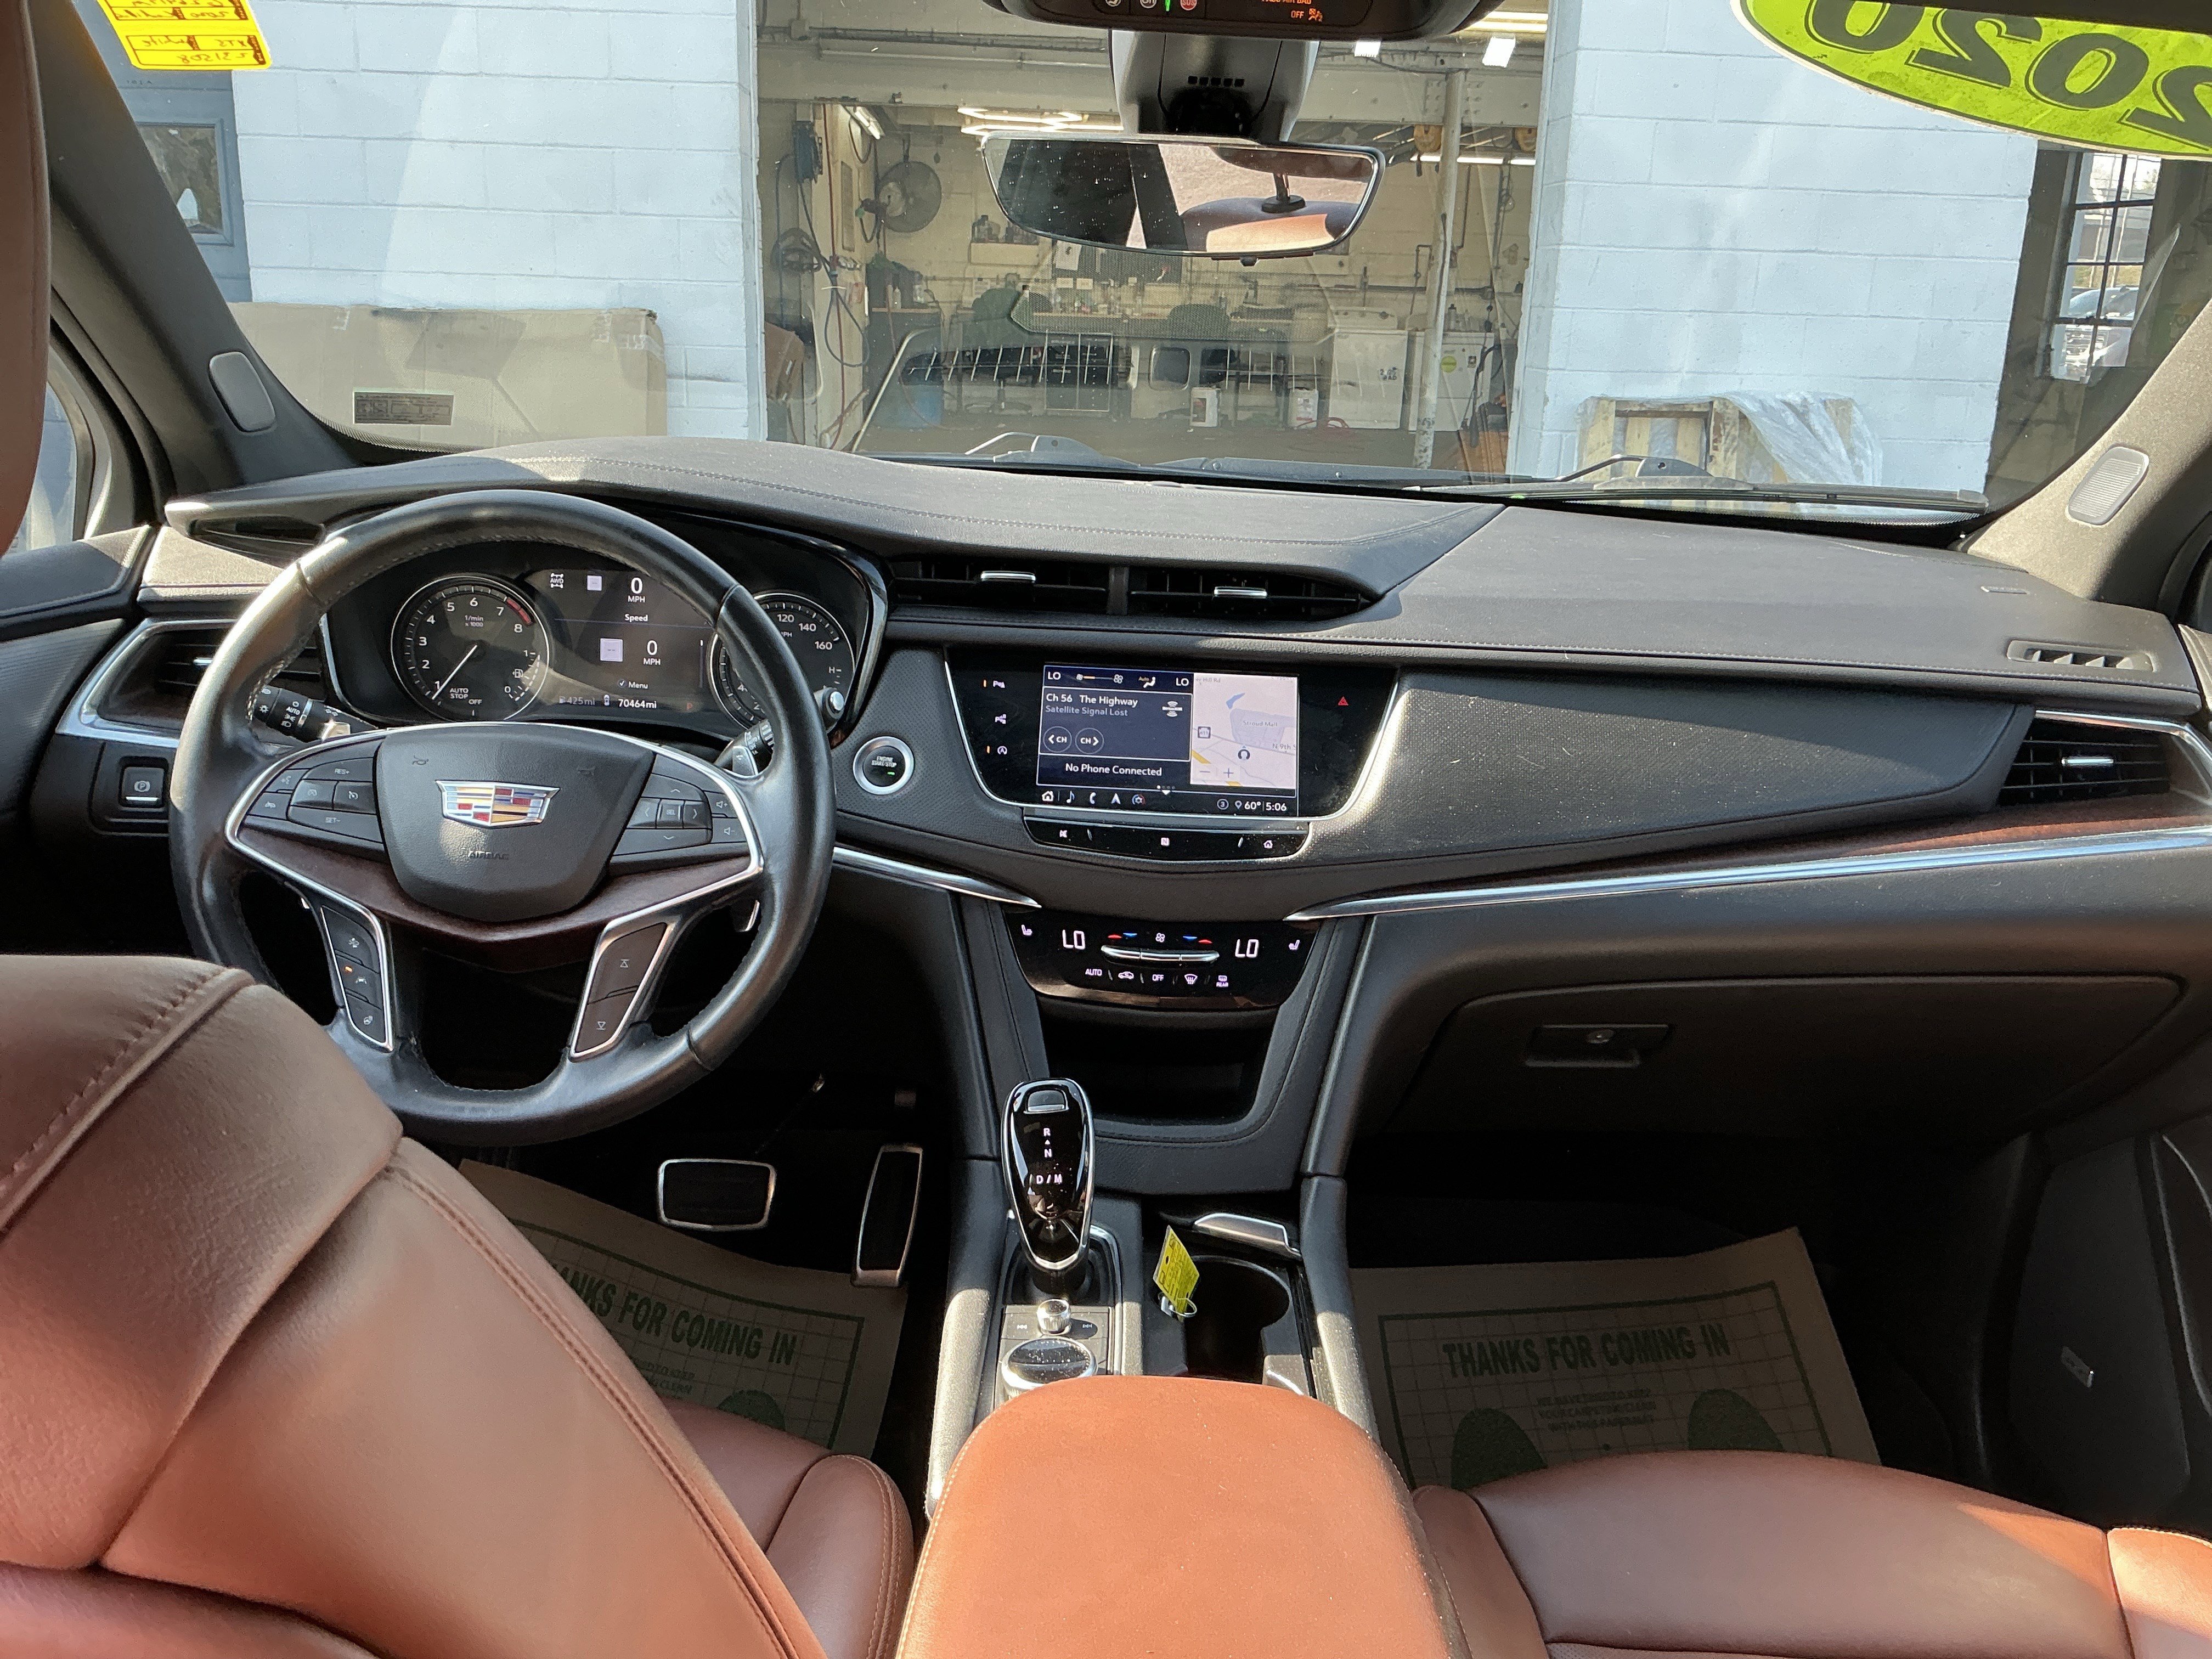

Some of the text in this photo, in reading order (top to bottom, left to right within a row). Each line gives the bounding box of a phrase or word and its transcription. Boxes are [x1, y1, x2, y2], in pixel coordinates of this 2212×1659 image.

[1290, 10, 1305, 19] OFF
[630, 577, 644, 594] 0
[447, 601, 455, 612] 5
[470, 597, 478, 607] 6
[496, 606, 505, 617] 7
[426, 614, 436, 624] 4
[624, 613, 648, 623] Speed
[777, 613, 795, 624] 120
[514, 623, 523, 634] 8
[798, 622, 817, 633] 140
[419, 636, 428, 647] 3
[815, 641, 833, 651] 160
[523, 649, 529, 657] 1
[646, 640, 658, 656] 0
[421, 659, 430, 669] 2
[643, 658, 662, 666] MPH
[828, 666, 836, 674] H
[1047, 671, 1062, 680] LO
[434, 680, 441, 690] 1
[628, 680, 648, 690] Menu
[1175, 677, 1189, 687] LO
[504, 685, 511, 695] 0
[1046, 692, 1138, 708] Ch 56 The Highway
[286, 706, 301, 715] AUTO
[1045, 704, 1128, 718] Satellite Signal Lost
[1080, 737, 1091, 745] CH
[1065, 763, 1163, 777] No Phone Connected
[1244, 800, 1261, 811] 60°
[1266, 802, 1287, 812] 5:06
[665, 808, 676, 817] SEL
[467, 850, 509, 860] AIRBAG
[1062, 929, 1086, 951] LO
[1234, 939, 1260, 959] LO
[1085, 968, 1102, 977] AUTO
[1152, 974, 1164, 982] OFF
[1043, 1127, 1051, 1136] R
[1045, 1148, 1053, 1158] N
[618, 1290, 668, 1337] FOR
[671, 1310, 764, 1359] COMING
[769, 1330, 798, 1367] IN
[1442, 1322, 1731, 1378] THANKS FOR COMING IN
